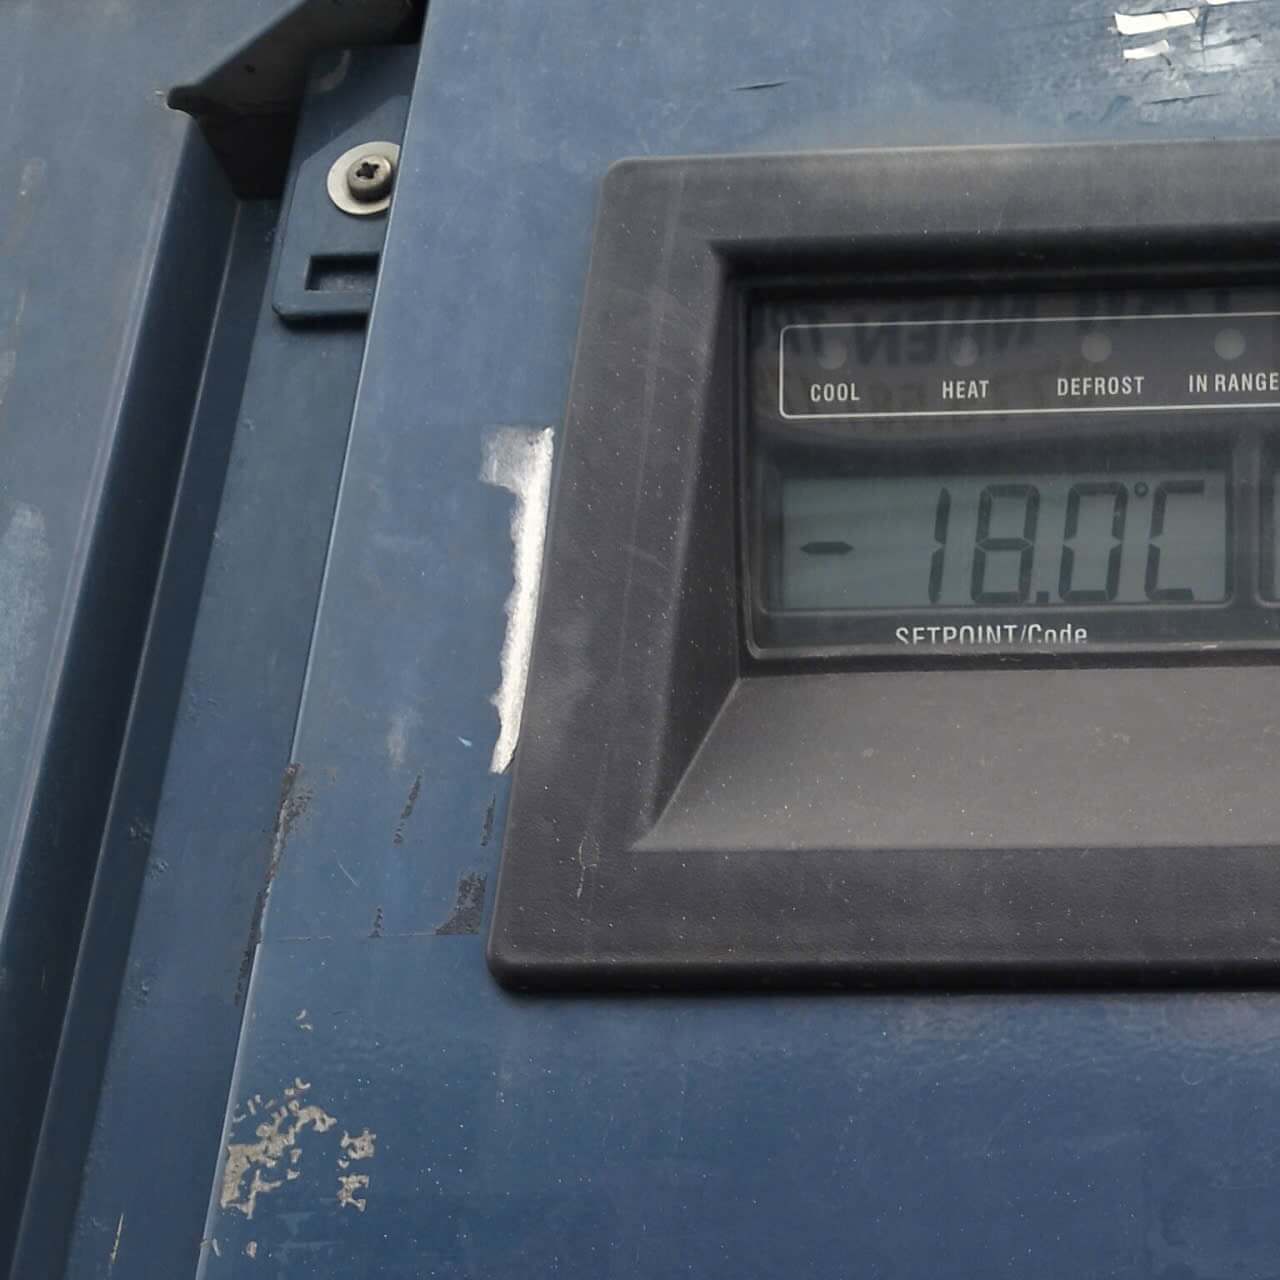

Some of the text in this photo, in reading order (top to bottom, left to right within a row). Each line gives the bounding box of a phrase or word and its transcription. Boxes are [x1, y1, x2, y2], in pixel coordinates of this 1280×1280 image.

[810, 382, 861, 403] COOL
[941, 379, 990, 401] HEAT
[1056, 375, 1145, 397] DEFROST
[1188, 371, 1280, 393] IN RANGE
